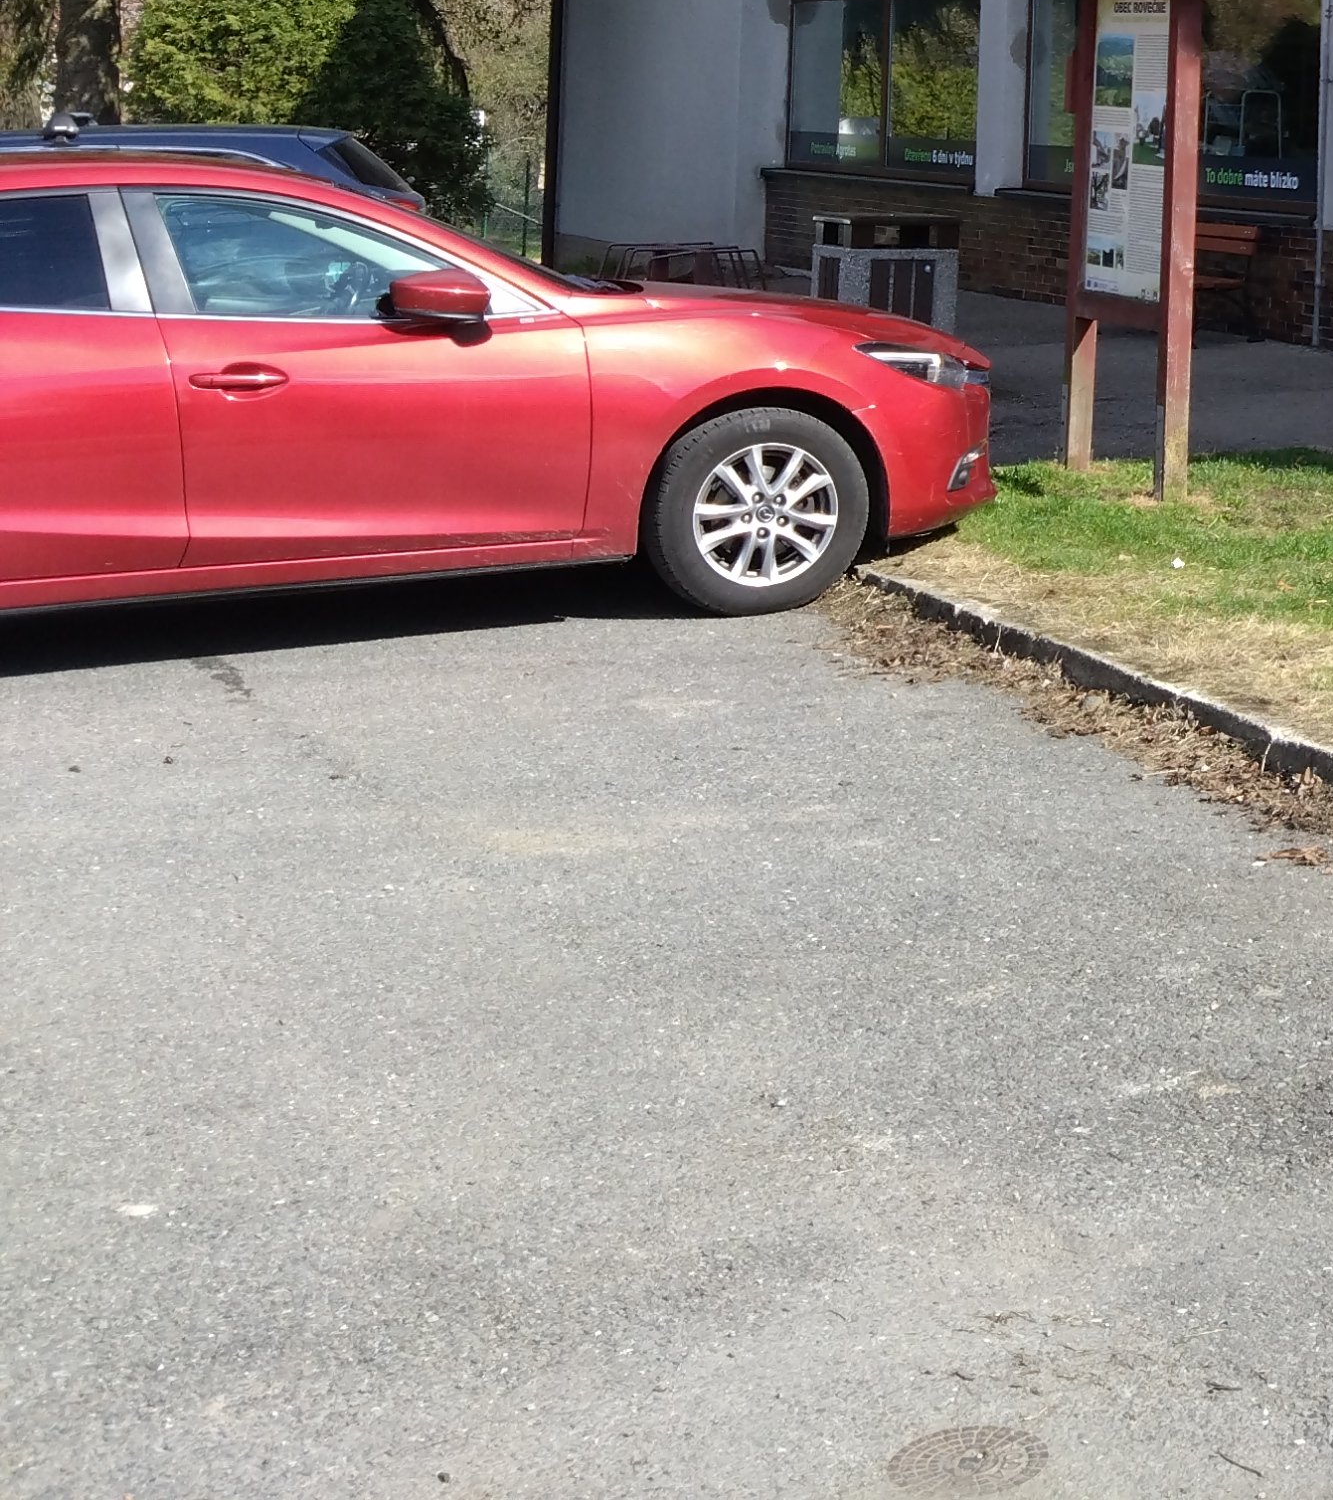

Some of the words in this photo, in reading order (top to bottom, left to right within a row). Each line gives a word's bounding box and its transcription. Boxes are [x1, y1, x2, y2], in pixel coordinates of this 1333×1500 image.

[1113, 1, 1132, 13] OBEC
[1205, 167, 1216, 184] To
[1217, 167, 1243, 186] dobré
[1244, 169, 1268, 188] máte
[1269, 170, 1300, 190] blízko
